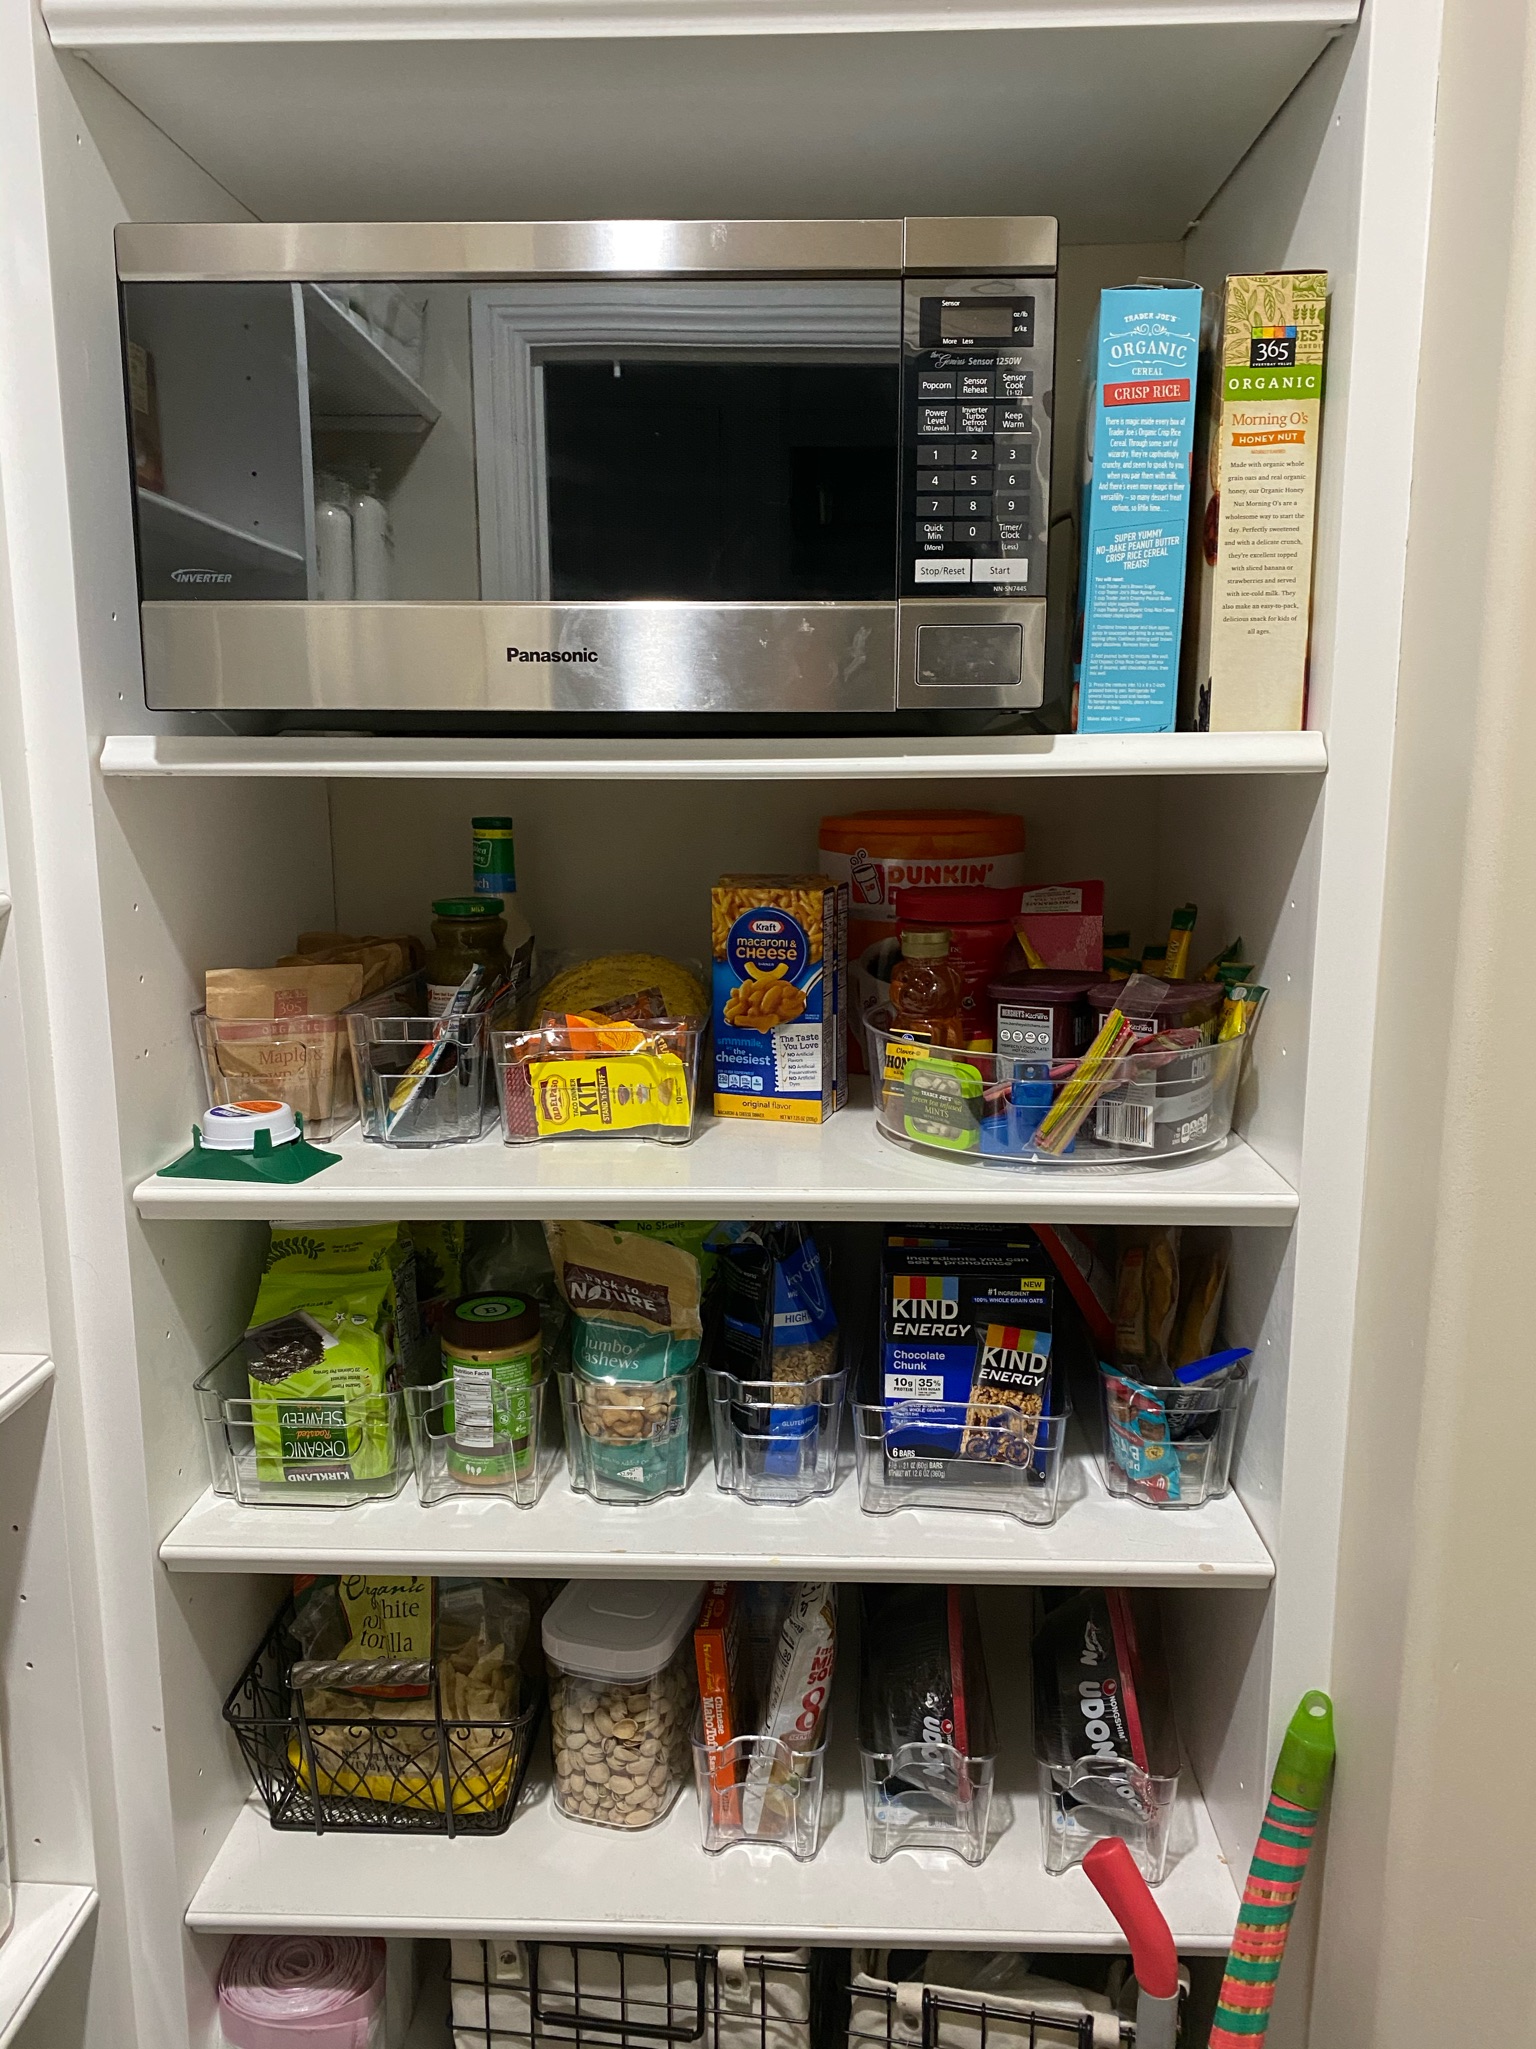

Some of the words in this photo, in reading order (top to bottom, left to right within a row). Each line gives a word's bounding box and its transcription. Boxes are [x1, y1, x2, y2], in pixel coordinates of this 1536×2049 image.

[1124, 312, 1154, 322] TRADER
[1155, 312, 1177, 322] JOE'S
[1111, 340, 1187, 359] ORGANIC
[1256, 340, 1289, 361] 365
[923, 382, 951, 390] Popcorn
[1229, 376, 1315, 390] ORGANIC
[1114, 386, 1149, 400] CRISP
[1153, 385, 1180, 397] RICE
[1005, 412, 1023, 420] Keep
[1232, 413, 1288, 428] Morning
[1290, 412, 1308, 424] O's
[1240, 435, 1275, 443] HONEY
[933, 450, 938, 460] 1
[971, 450, 977, 460] 2
[1010, 450, 1015, 459] 3
[932, 476, 938, 485] 4
[971, 476, 976, 485] 5
[1009, 475, 1015, 485] 6
[932, 502, 938, 511] 7
[970, 501, 976, 510] 8
[1008, 501, 1014, 510] 9
[924, 524, 944, 532] Quick
[970, 527, 976, 536] 0
[1114, 532, 1136, 543] SUPER
[1138, 529, 1162, 540] YUMMY
[1096, 542, 1126, 555] NO-BAKE
[1128, 540, 1154, 551] PEANUT
[1155, 536, 1180, 547] BUTTER
[1106, 552, 1125, 563] CRISP
[1127, 550, 1142, 560] RICE
[1144, 547, 1168, 558] CEREAL
[990, 566, 1010, 574] Start
[1123, 560, 1150, 570] TREATS!
[921, 566, 965, 577] Stop/Reset
[176, 574, 232, 582] INVERTER
[506, 647, 598, 662] Panasonic
[888, 864, 994, 885] DUNKIN'
[756, 923, 776, 931] Kraft
[737, 938, 788, 947] macaroni
[279, 1000, 302, 1015] 365
[259, 1047, 306, 1066] Maple
[314, 1050, 323, 1060] &
[716, 1052, 770, 1066] cheesiest
[577, 1078, 599, 1116] KIT
[921, 1090, 938, 1099] TRADER
[742, 1101, 770, 1109] original
[772, 1101, 791, 1110] flavor
[929, 1098, 939, 1106] tea
[940, 1100, 962, 1112] infused
[601, 1101, 610, 1121] STAND
[925, 1106, 949, 1118] MINTS
[637, 1222, 652, 1231] No
[656, 1220, 685, 1230] Shells
[585, 1274, 618, 1290] back
[624, 1284, 639, 1294] to
[892, 1299, 959, 1319] KIND
[892, 1322, 971, 1337] ENERGY
[584, 1336, 632, 1355] Jumbo
[893, 1350, 946, 1360] Chocolate
[981, 1346, 1048, 1373] KIND
[454, 1367, 473, 1376] Nutrition
[893, 1361, 926, 1371] Chunk
[894, 1378, 913, 1388] 10g
[918, 1378, 941, 1387] 35%
[979, 1369, 1044, 1387] ENERGY
[296, 1430, 331, 1439] Roasted
[285, 1440, 346, 1458] ORGANIC
[892, 1448, 898, 1457] 6
[288, 1471, 350, 1482] KIRKLAND
[342, 1576, 425, 1609] Organic
[361, 1631, 413, 1652] torlla
[795, 1686, 825, 1732] 8
[714, 1696, 725, 1735] Chinese
[1078, 1681, 1117, 1758] UDON
[1109, 1695, 1126, 1740] NONGSHIM
[921, 1716, 945, 1780] UDON
